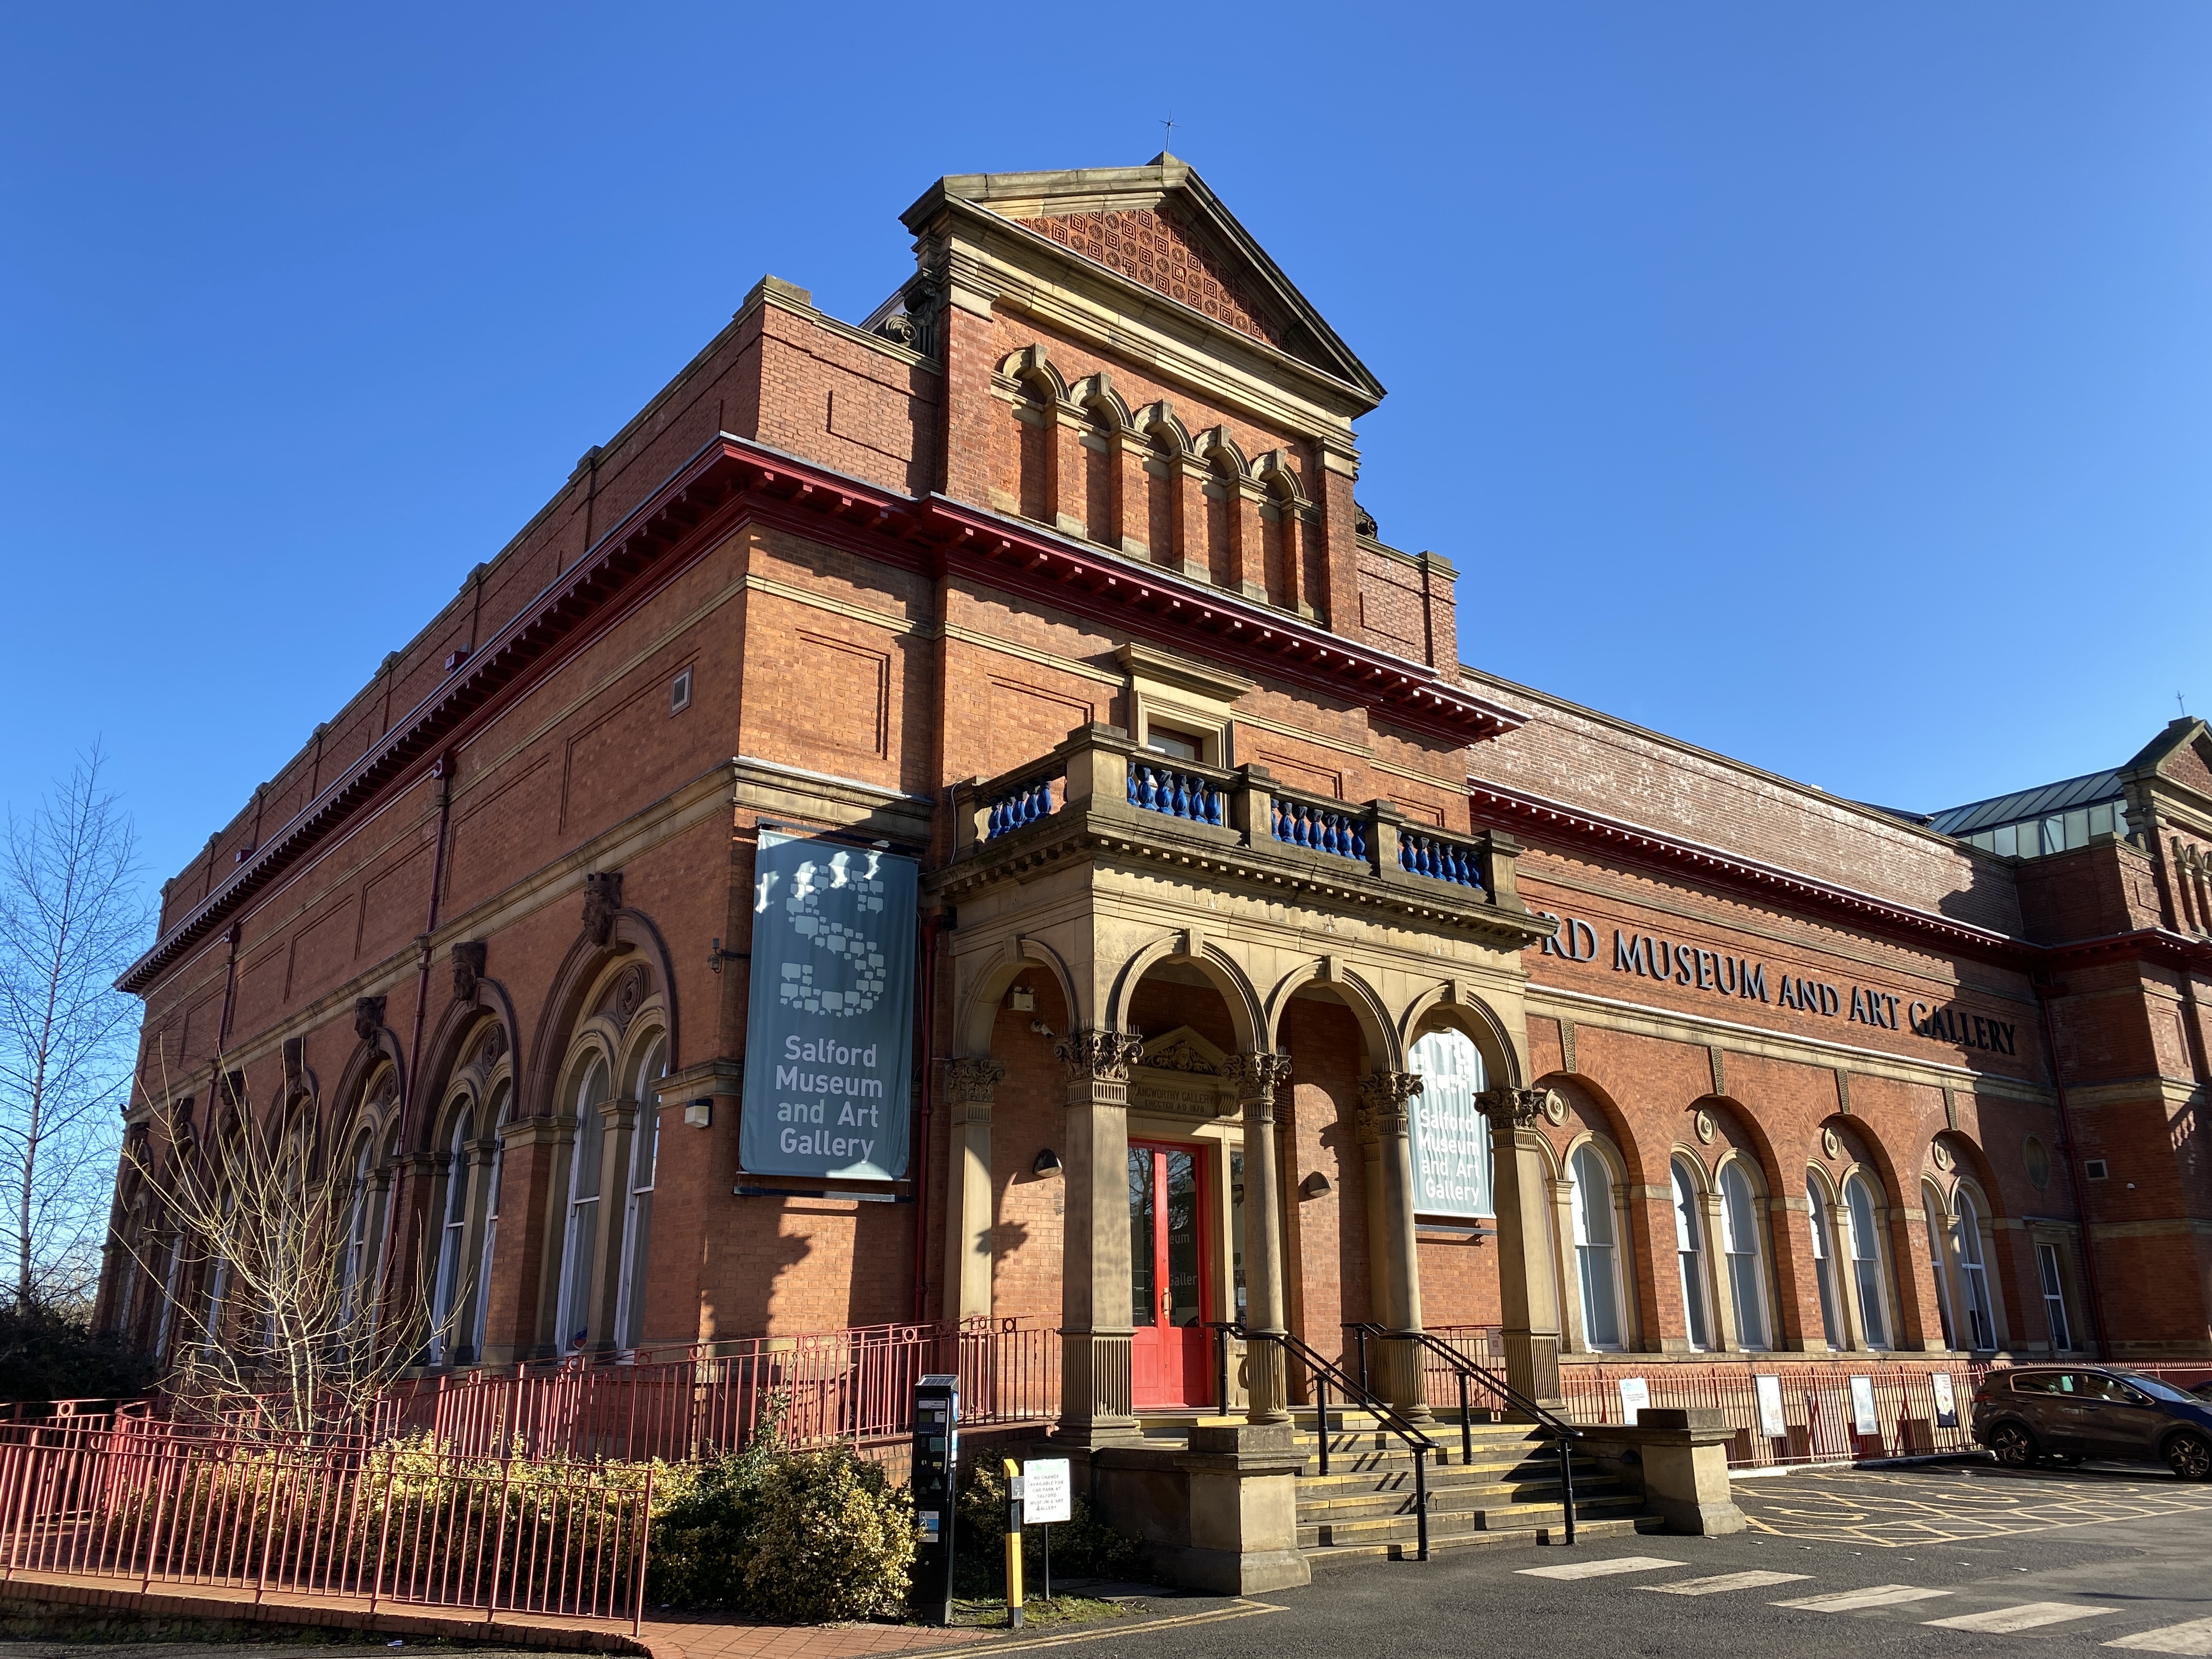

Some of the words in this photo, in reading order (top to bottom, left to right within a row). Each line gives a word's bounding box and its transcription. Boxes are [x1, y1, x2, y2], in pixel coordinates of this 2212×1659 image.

[1612, 929, 1770, 1003] MUSEUM
[1777, 974, 1841, 1017] AND
[1848, 986, 1900, 1031] ART
[1908, 1000, 2016, 1056] GALLERY
[784, 1035, 877, 1068] Salford
[775, 1064, 883, 1098] Museum
[1145, 1099, 1173, 1109] ERECTED
[1182, 1092, 1213, 1105] GALLERY
[777, 1099, 824, 1124] and
[837, 1101, 878, 1128] Art
[1420, 1108, 1474, 1133] Salford
[780, 1127, 874, 1164] Gallery
[1418, 1130, 1480, 1156] Museum
[1421, 1156, 1448, 1176] and
[1456, 1158, 1480, 1179] Art
[1425, 1177, 1479, 1206] Gallery
